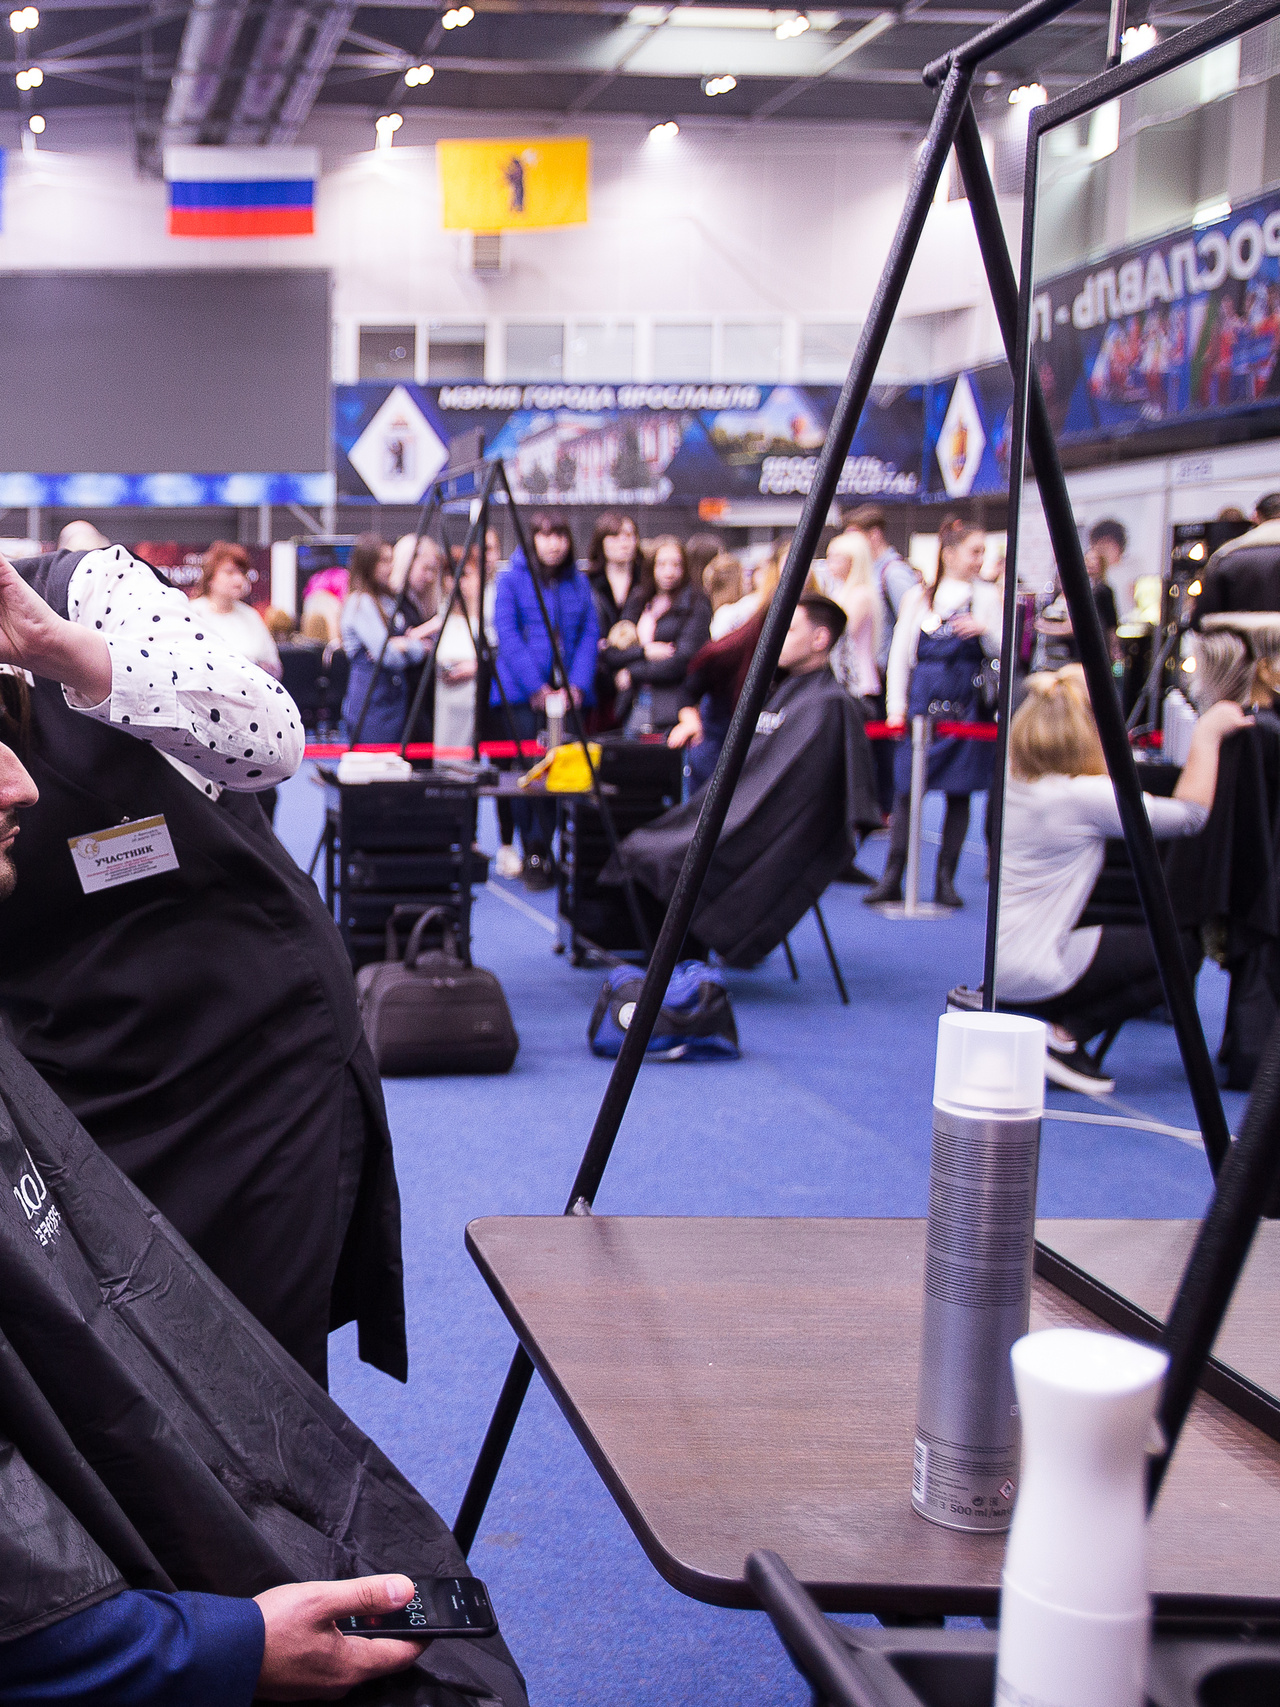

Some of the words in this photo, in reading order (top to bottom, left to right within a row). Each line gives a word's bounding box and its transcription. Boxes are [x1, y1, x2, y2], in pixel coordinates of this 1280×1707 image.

[522, 385, 616, 411] ГОРОДА
[617, 385, 761, 411] ЯРОСЛАВЛЯ
[95, 845, 154, 867] УЧАСТНИК
[950, 1504, 972, 1516] 500
